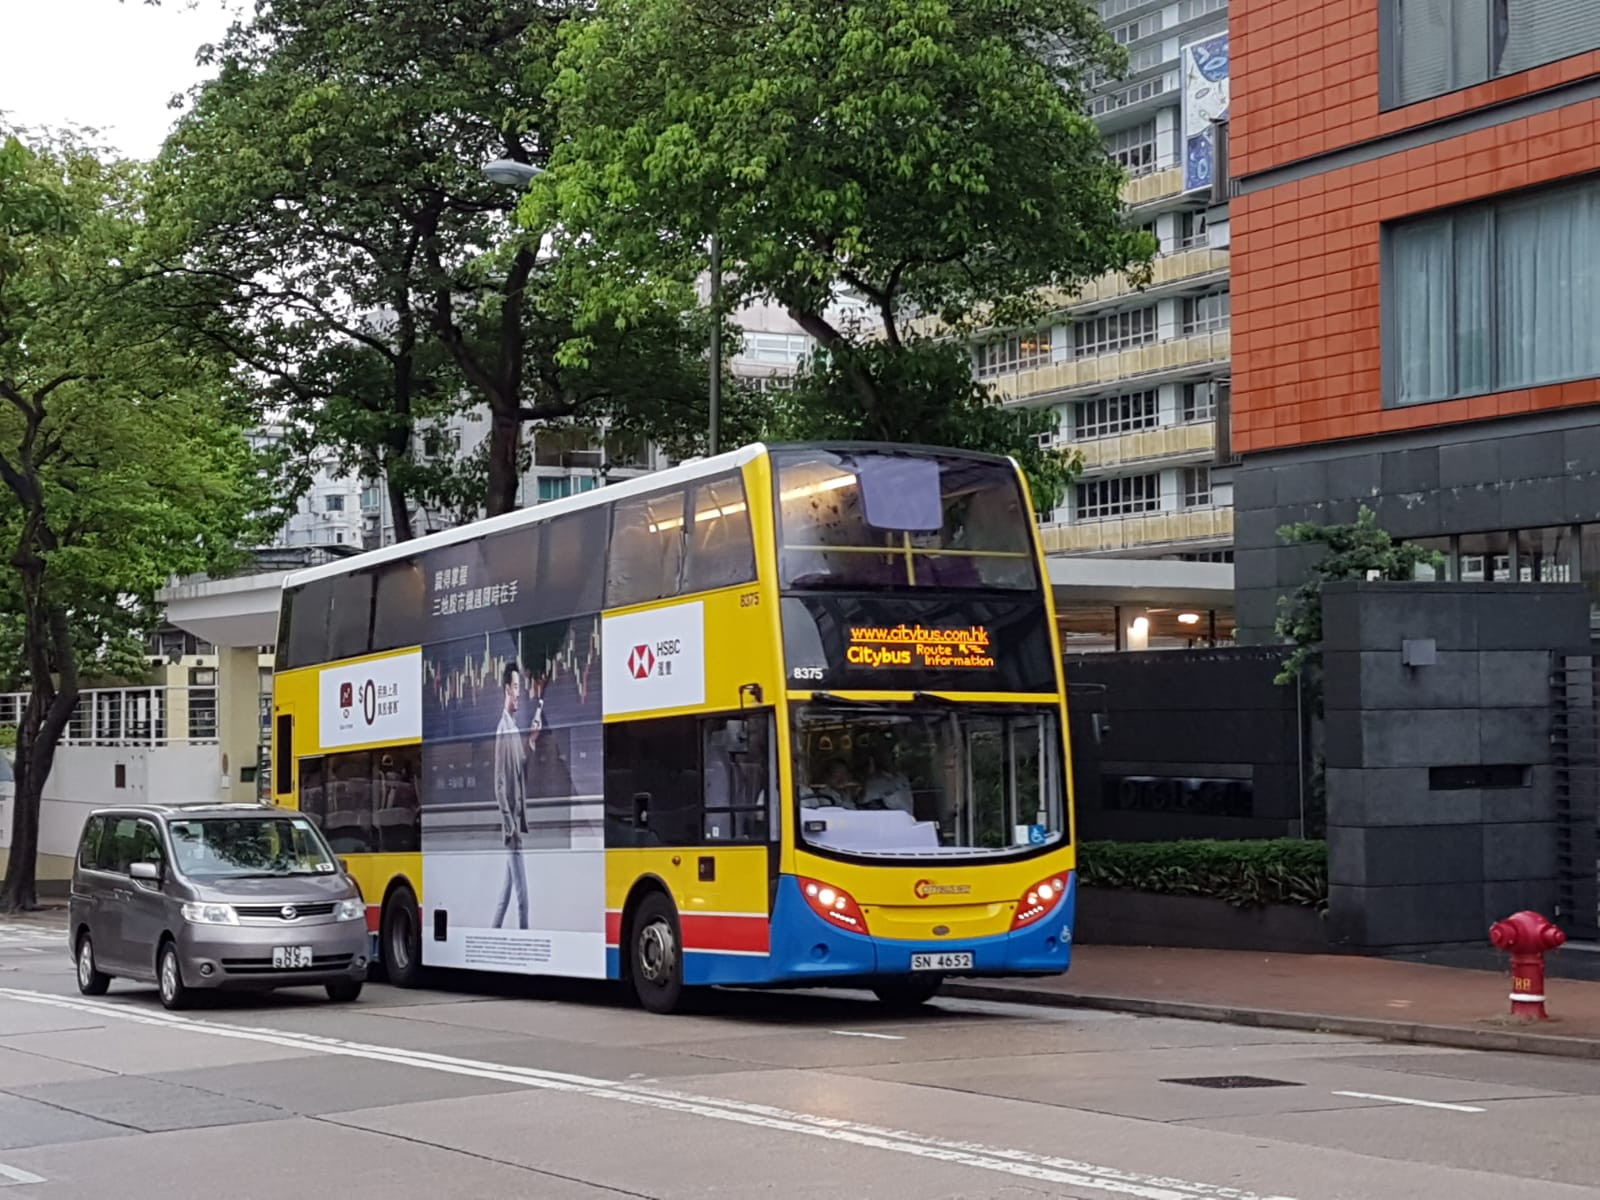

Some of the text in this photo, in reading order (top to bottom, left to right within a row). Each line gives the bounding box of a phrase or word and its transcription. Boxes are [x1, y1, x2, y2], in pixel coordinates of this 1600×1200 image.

[851, 624, 988, 642] www.citybus.com.hk
[656, 639, 680, 656] HSBC
[916, 644, 952, 655] Route
[847, 645, 911, 667] Citybus
[924, 655, 994, 666] Information
[793, 667, 823, 679] 8375
[284, 946, 300, 957] NC
[914, 955, 970, 968] SN 4652
